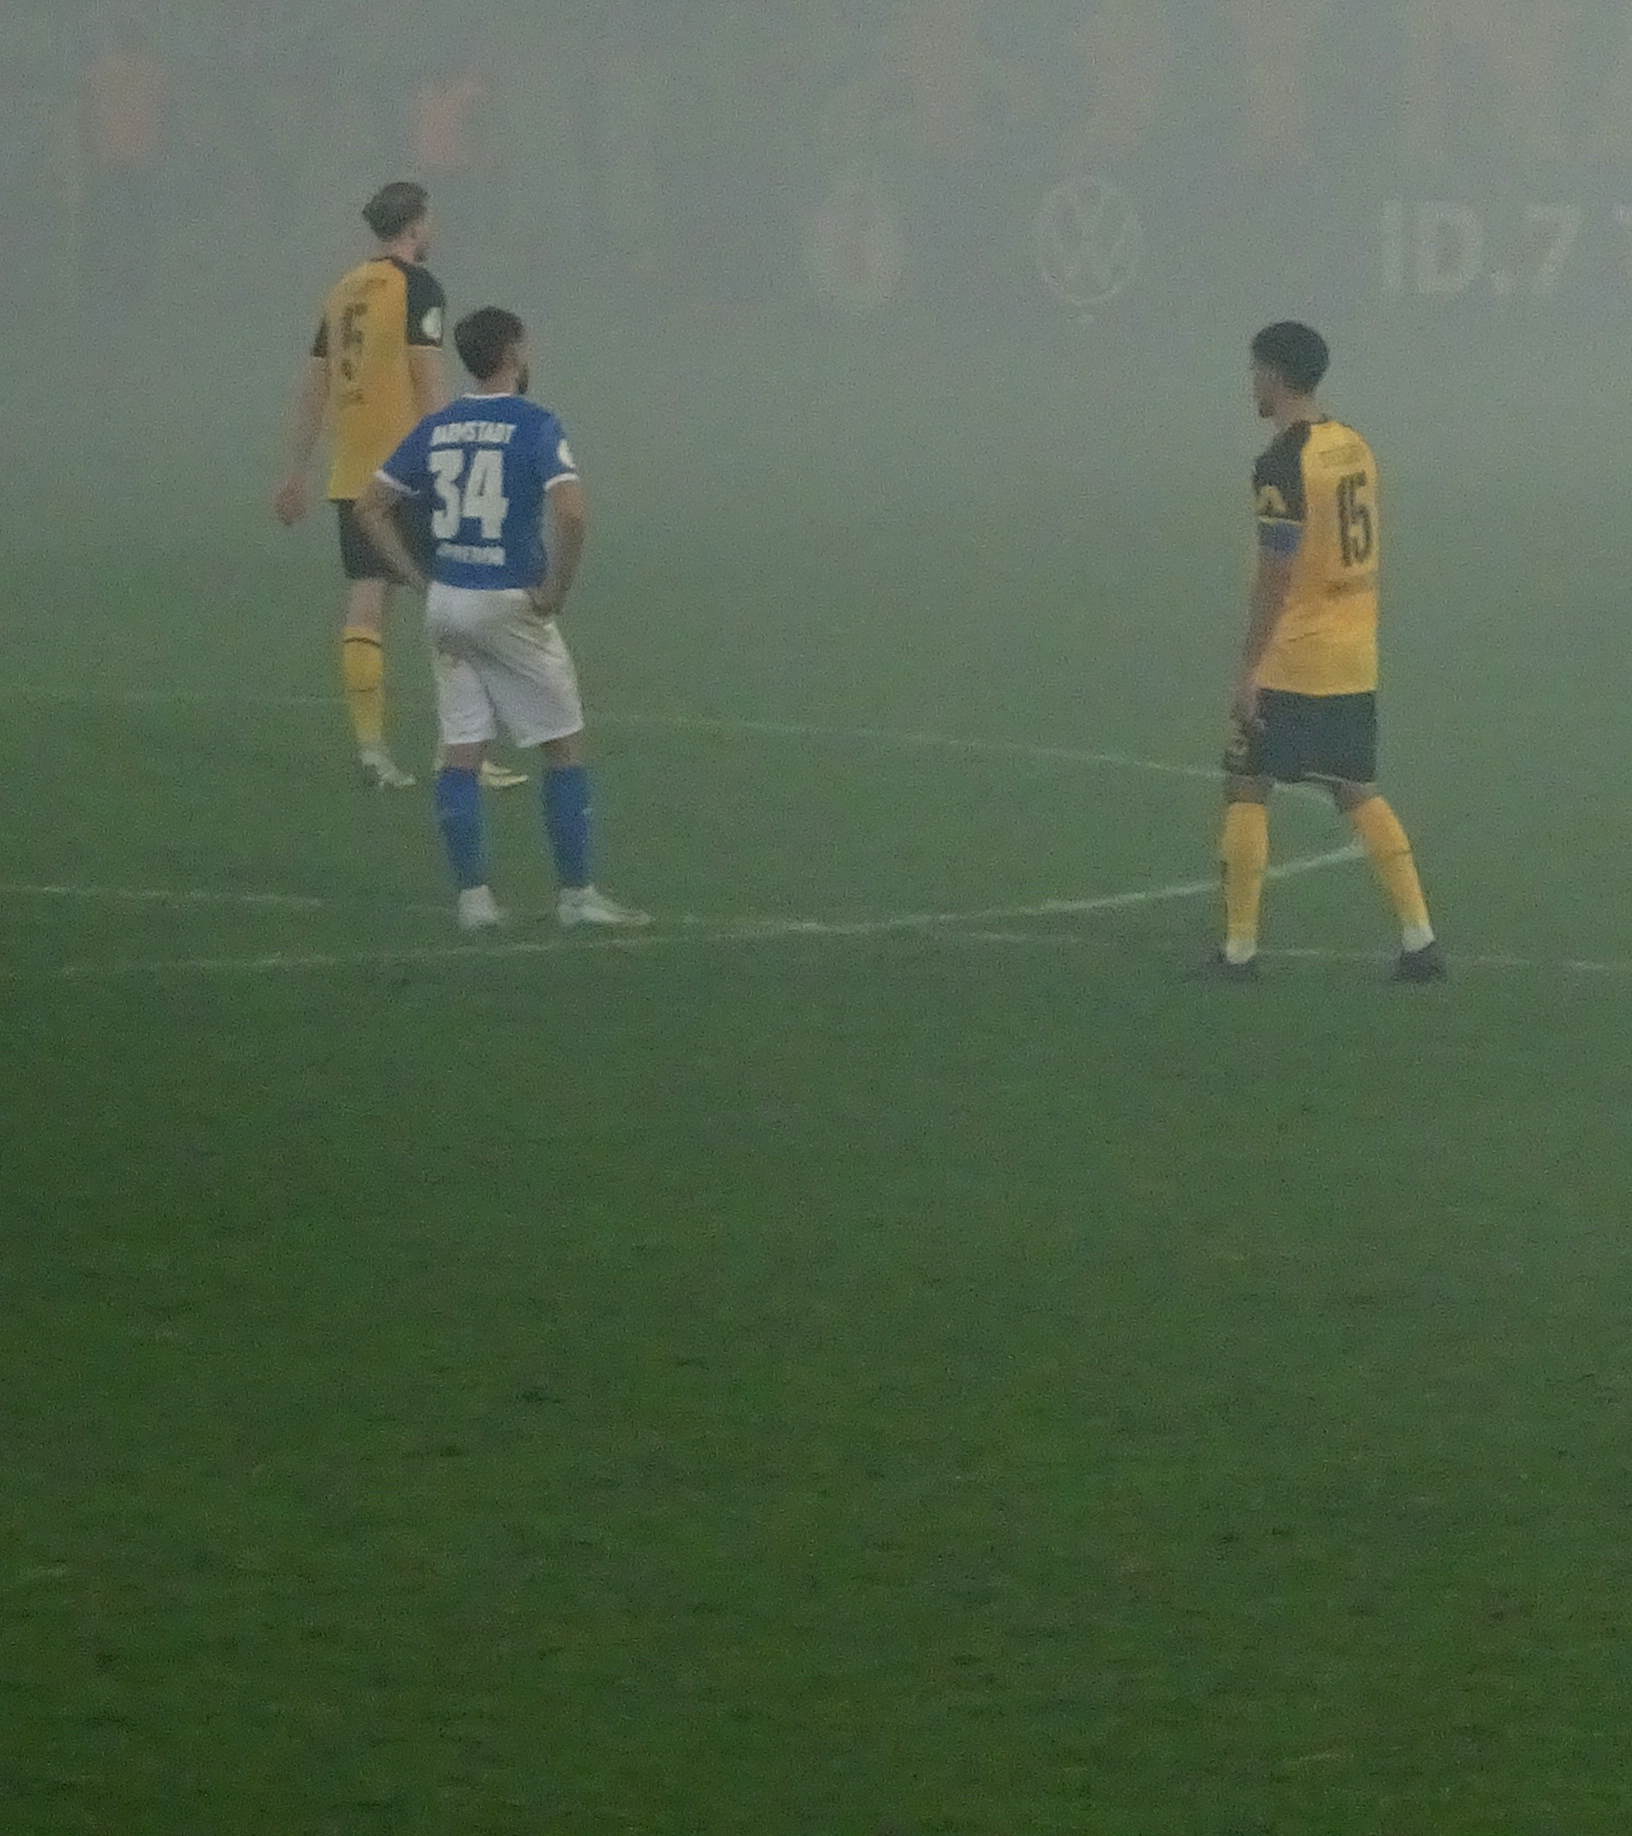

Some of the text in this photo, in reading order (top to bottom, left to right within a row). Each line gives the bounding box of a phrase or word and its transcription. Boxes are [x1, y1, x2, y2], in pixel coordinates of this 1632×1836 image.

[1378, 200, 1586, 301] ID.7
[428, 448, 510, 540] 34
[1335, 471, 1374, 567] 15
